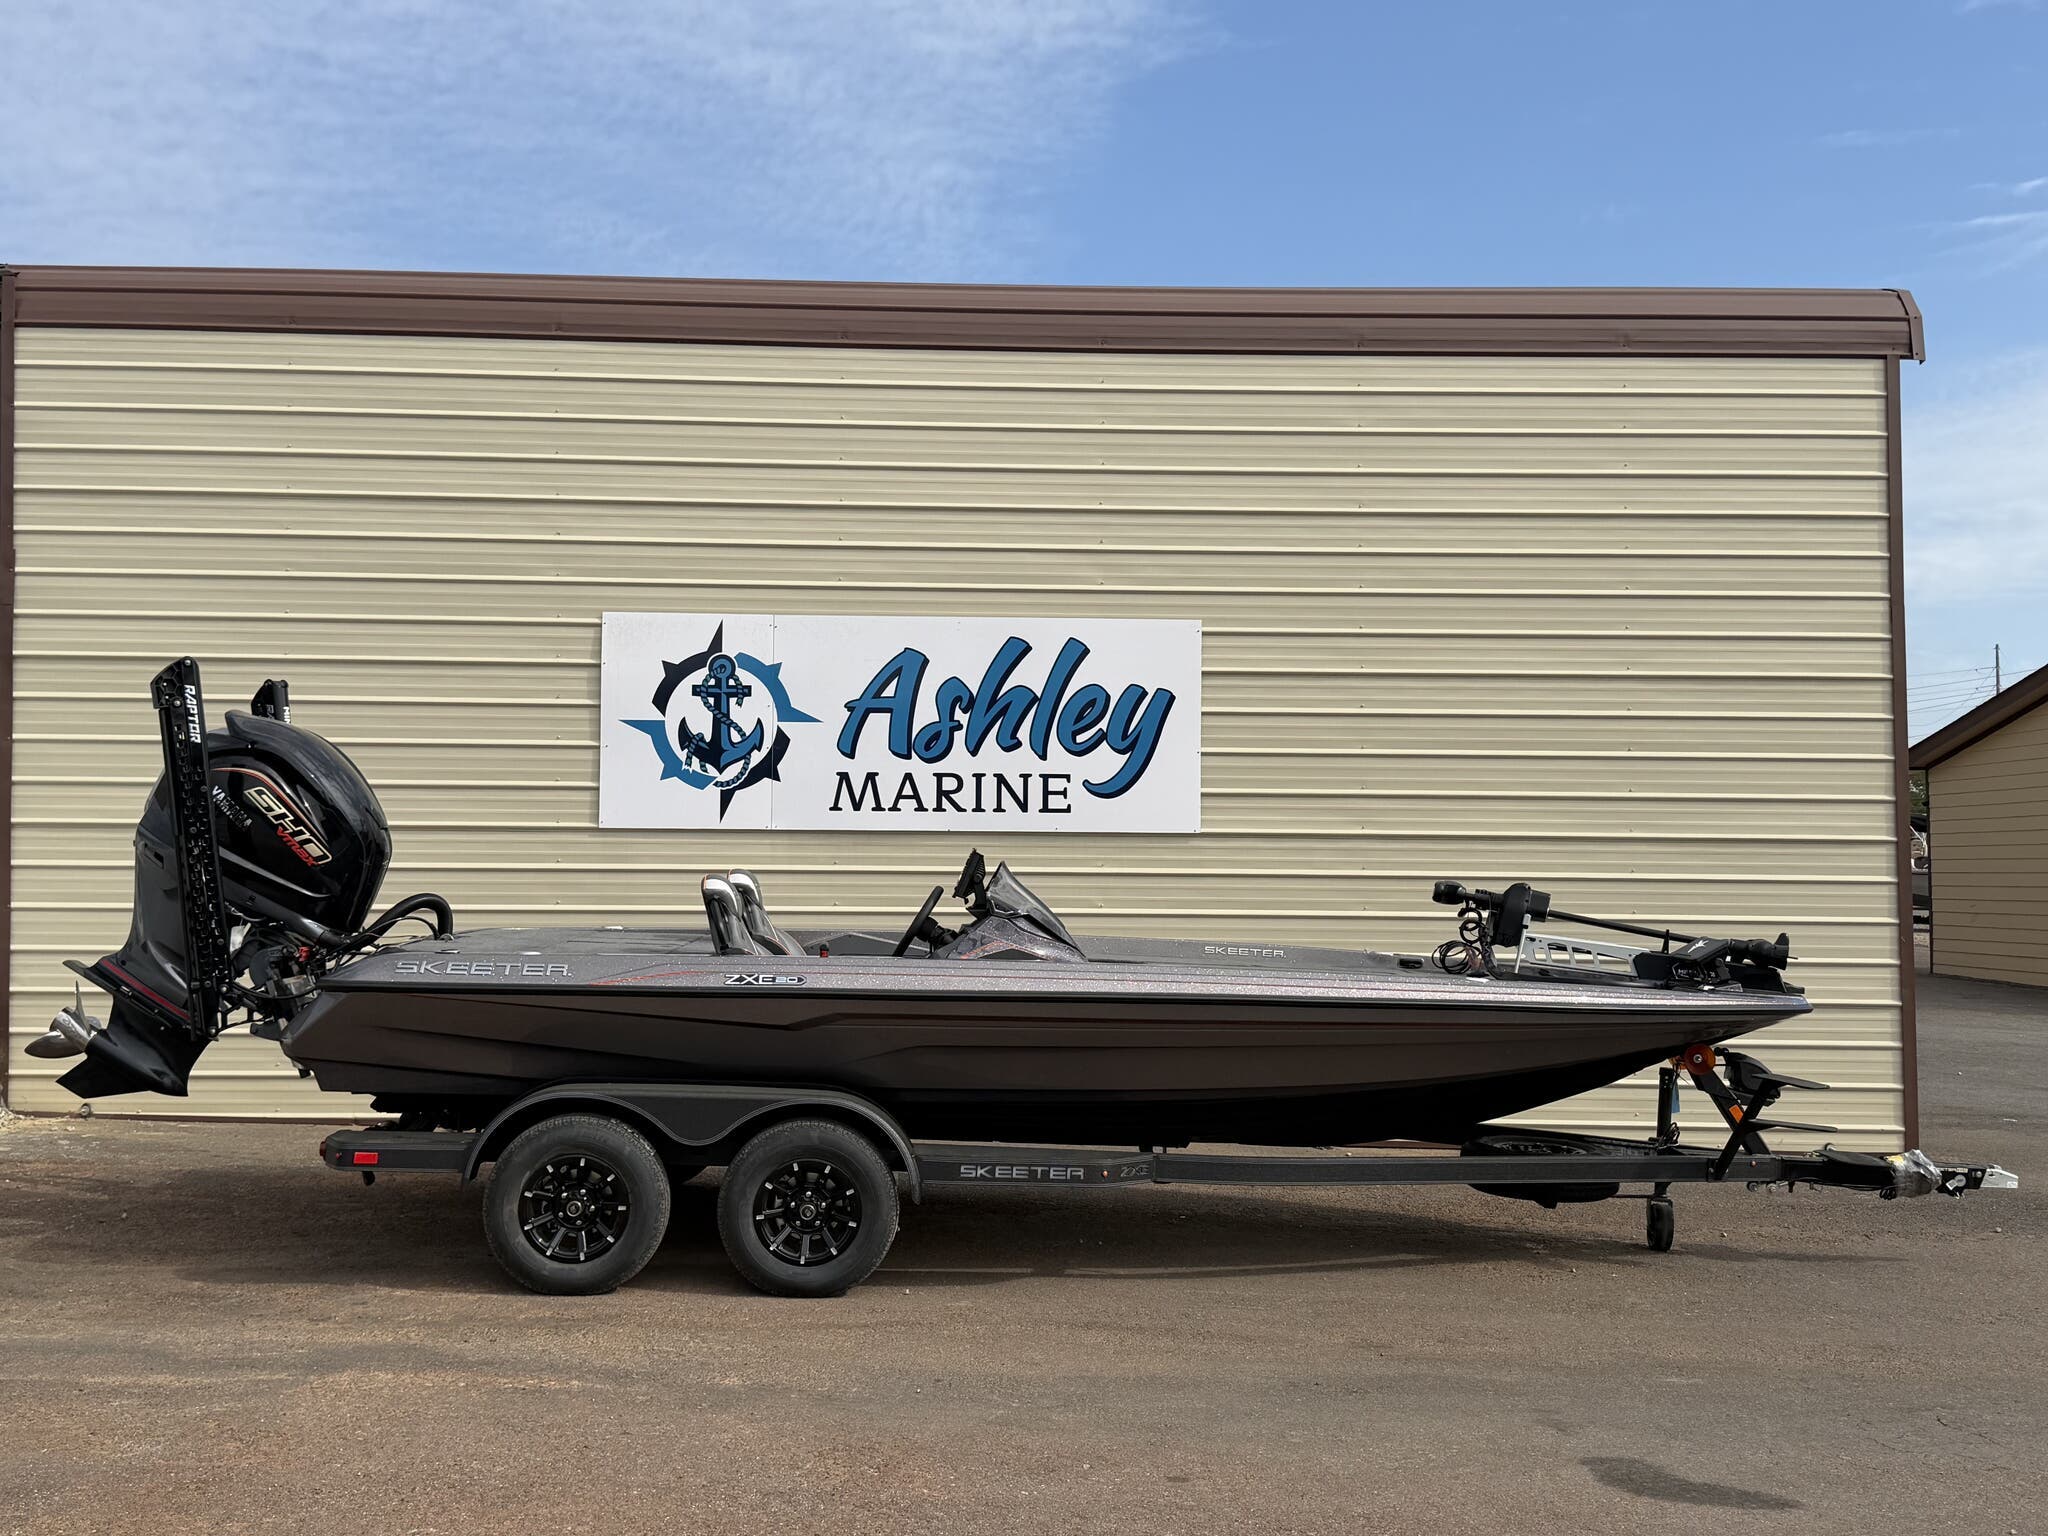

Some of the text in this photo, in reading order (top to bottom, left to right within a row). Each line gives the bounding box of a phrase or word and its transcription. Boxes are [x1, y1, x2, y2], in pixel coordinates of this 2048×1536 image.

[183, 684, 201, 743] RAPTOR
[836, 636, 1176, 799] Ashley
[829, 772, 1072, 813] MARINE
[243, 786, 333, 864] SHO
[395, 960, 572, 977] SKEETER
[1204, 946, 1284, 958] SKEETER
[960, 1165, 1085, 1180] SKEETER
